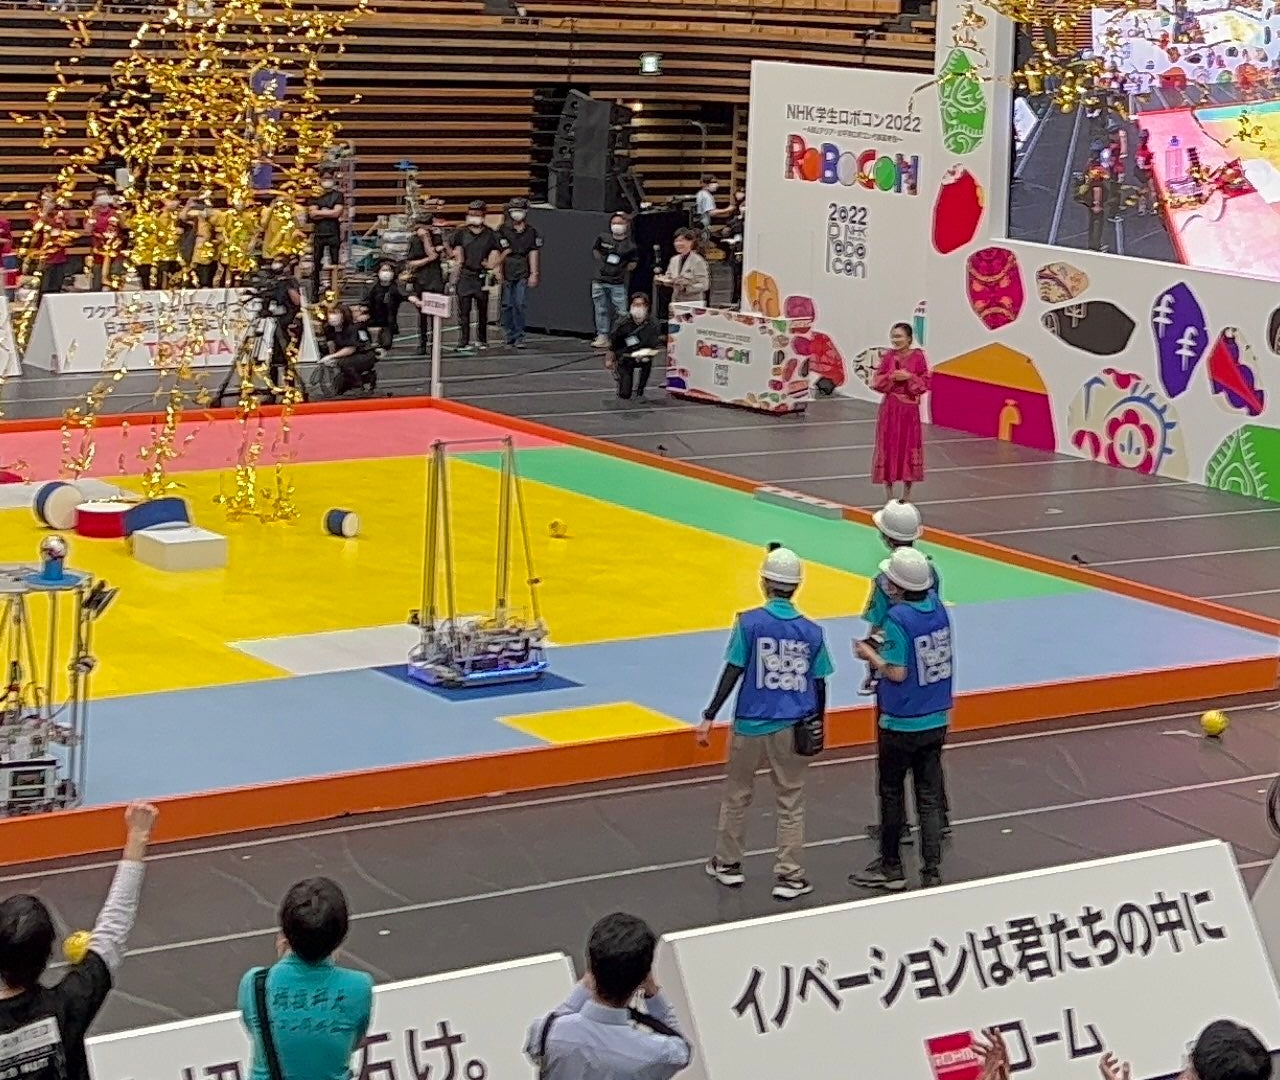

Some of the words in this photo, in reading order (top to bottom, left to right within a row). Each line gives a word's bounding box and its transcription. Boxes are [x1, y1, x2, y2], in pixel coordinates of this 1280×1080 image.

[786, 103, 922, 133] NHK学生ロボコン2022
[828, 203, 868, 226] 2022
[731, 890, 1228, 1034] イノベーションは君たちの中に
